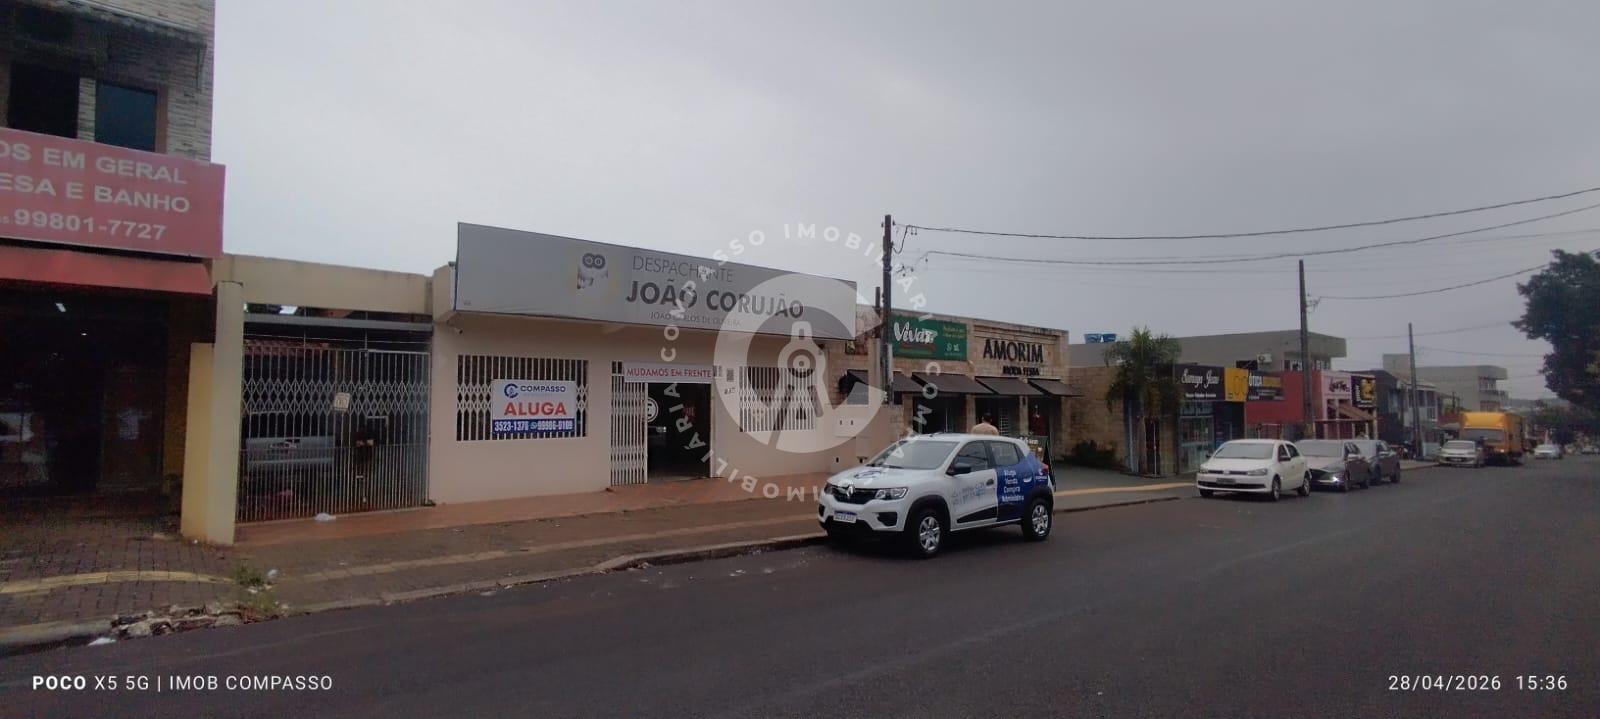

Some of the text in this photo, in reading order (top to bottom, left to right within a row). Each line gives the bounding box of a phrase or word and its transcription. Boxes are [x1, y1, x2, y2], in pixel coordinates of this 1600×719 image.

[43, 147, 85, 170] EM
[96, 156, 188, 185] GERAL
[66, 181, 84, 199] E
[95, 184, 190, 213] BANHO
[15, 208, 167, 240] 99801-7727
[632, 255, 734, 283] DESPACHANTE
[625, 278, 804, 319] JOÃO CORUJÃO
[982, 338, 1044, 363] AMORIM
[627, 367, 712, 378] MUDAMOS EM FRENTE
[520, 385, 566, 393] COMPASSO
[504, 401, 566, 416] ALUGA
